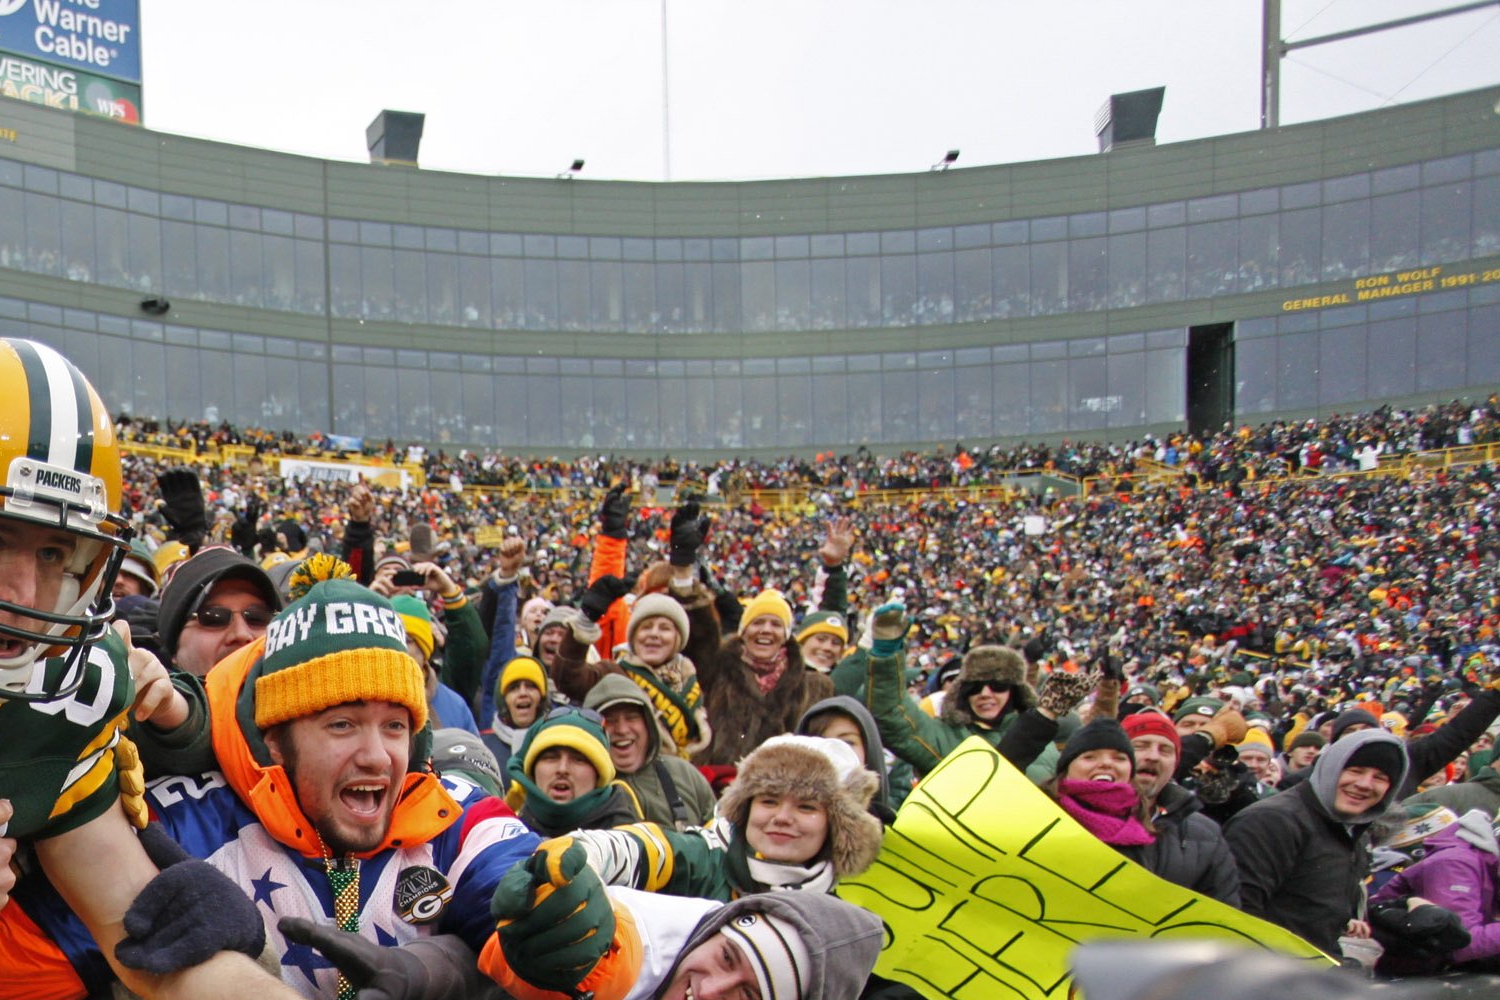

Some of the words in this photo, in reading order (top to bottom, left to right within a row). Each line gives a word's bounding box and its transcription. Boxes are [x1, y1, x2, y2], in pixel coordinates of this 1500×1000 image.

[34, 0, 130, 43] Warner
[1356, 276, 1390, 289] RON
[1397, 266, 1442, 283] WOLF
[1283, 293, 1350, 311] GENERAL
[1357, 280, 1434, 301] MANAGER
[36, 469, 81, 494] PACKERS
[264, 603, 317, 661] BAY
[396, 868, 432, 903] XLV
[399, 880, 439, 908] CHAMPIONS
